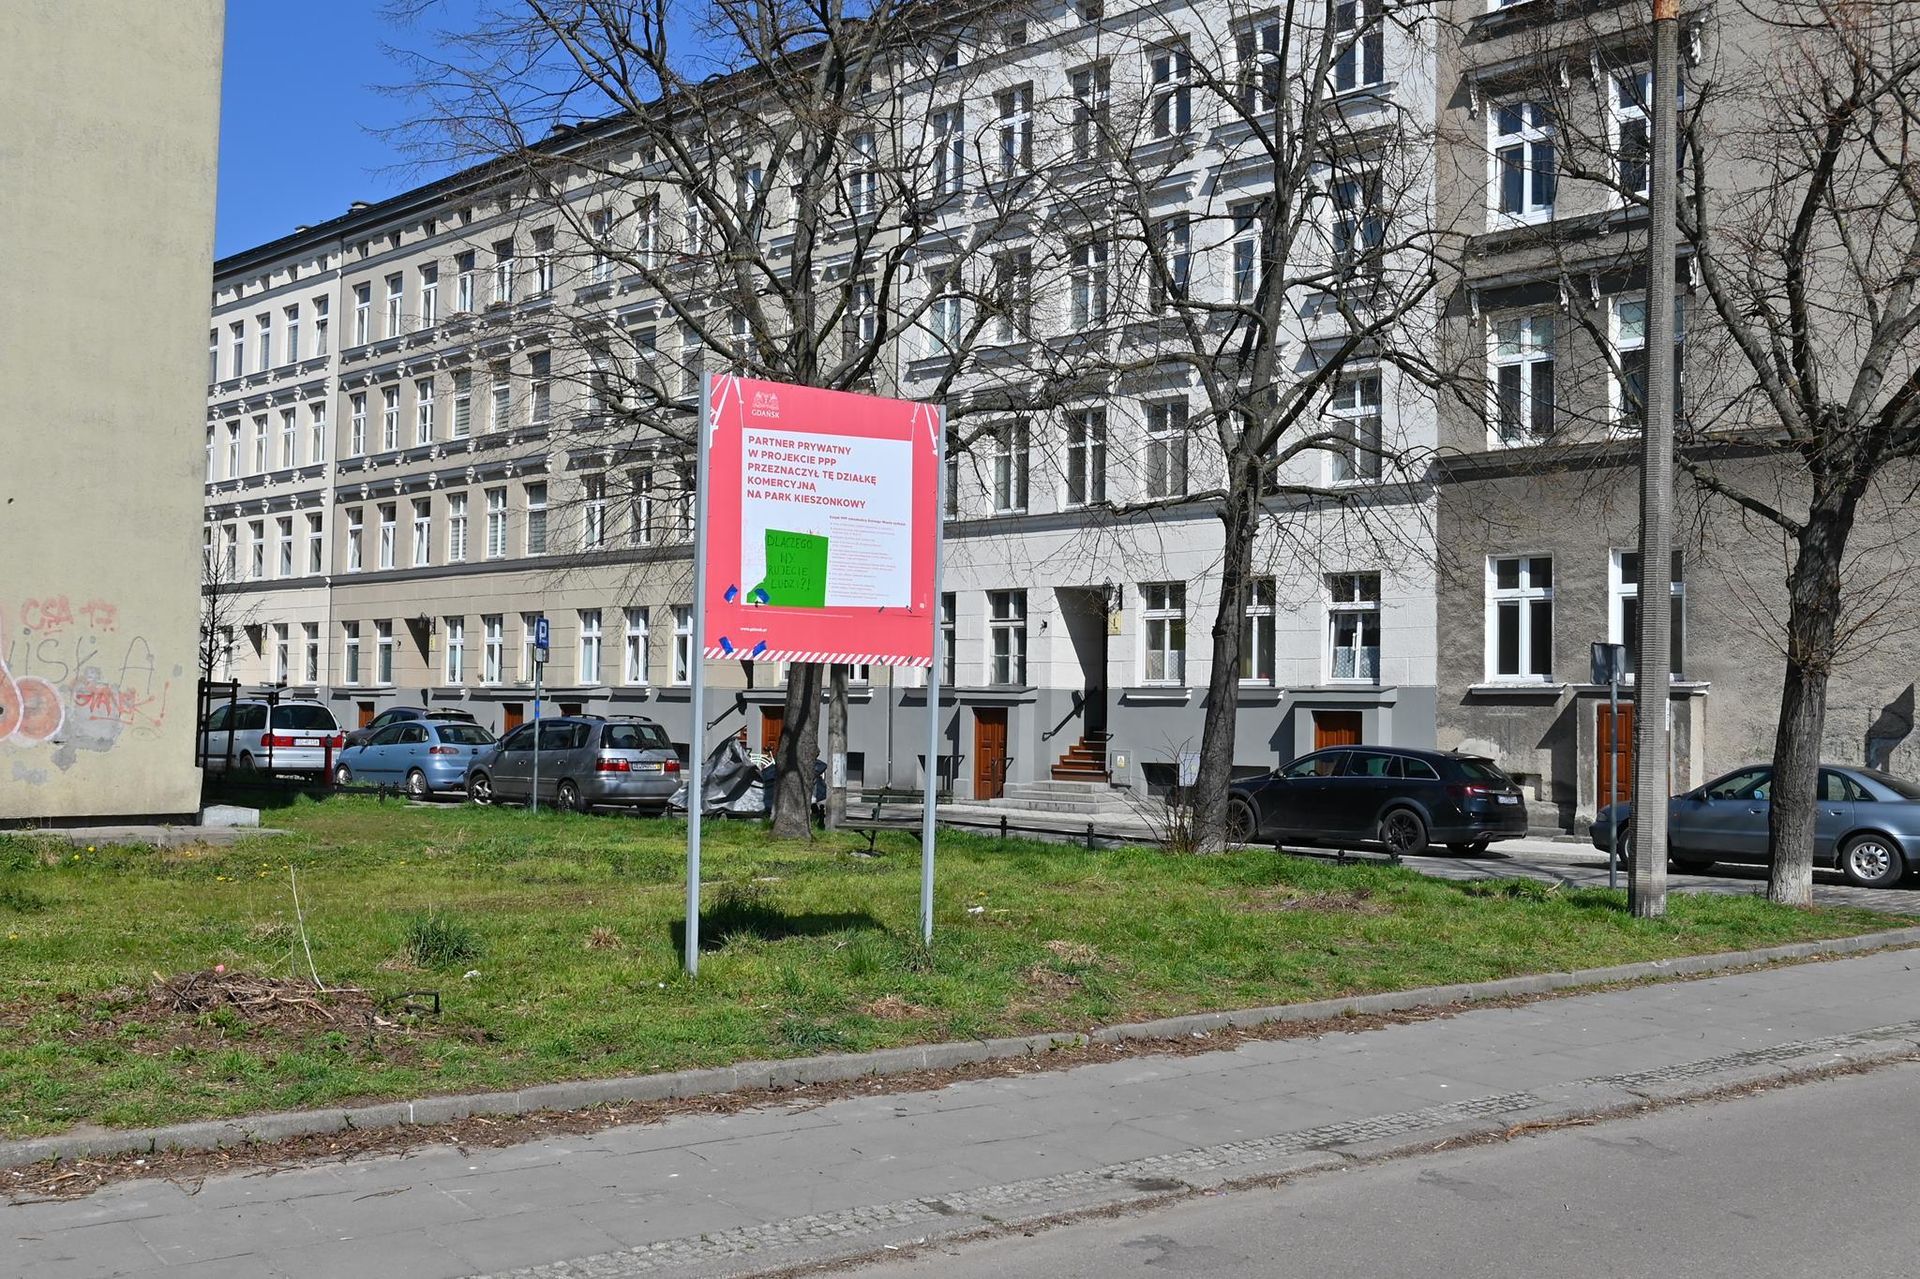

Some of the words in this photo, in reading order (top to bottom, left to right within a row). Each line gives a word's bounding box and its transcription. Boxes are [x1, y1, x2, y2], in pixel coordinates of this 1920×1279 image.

[751, 408, 780, 419] GDAŃSK
[748, 435, 795, 449] PARTNER
[797, 441, 852, 456] PRYWATNY
[748, 449, 758, 458] W
[761, 450, 816, 465] PROJEKCIE
[818, 457, 837, 467] PPP
[747, 463, 820, 479] PRZEZNACZYŁ
[822, 470, 835, 481] TĘ
[836, 472, 877, 486] DZIAŁKĘ
[747, 476, 816, 493] KOMERCYJNĄ
[747, 490, 762, 500] NA
[764, 491, 791, 502] PARK
[794, 493, 866, 509] KIESZONKOWY
[539, 621, 547, 642] P
